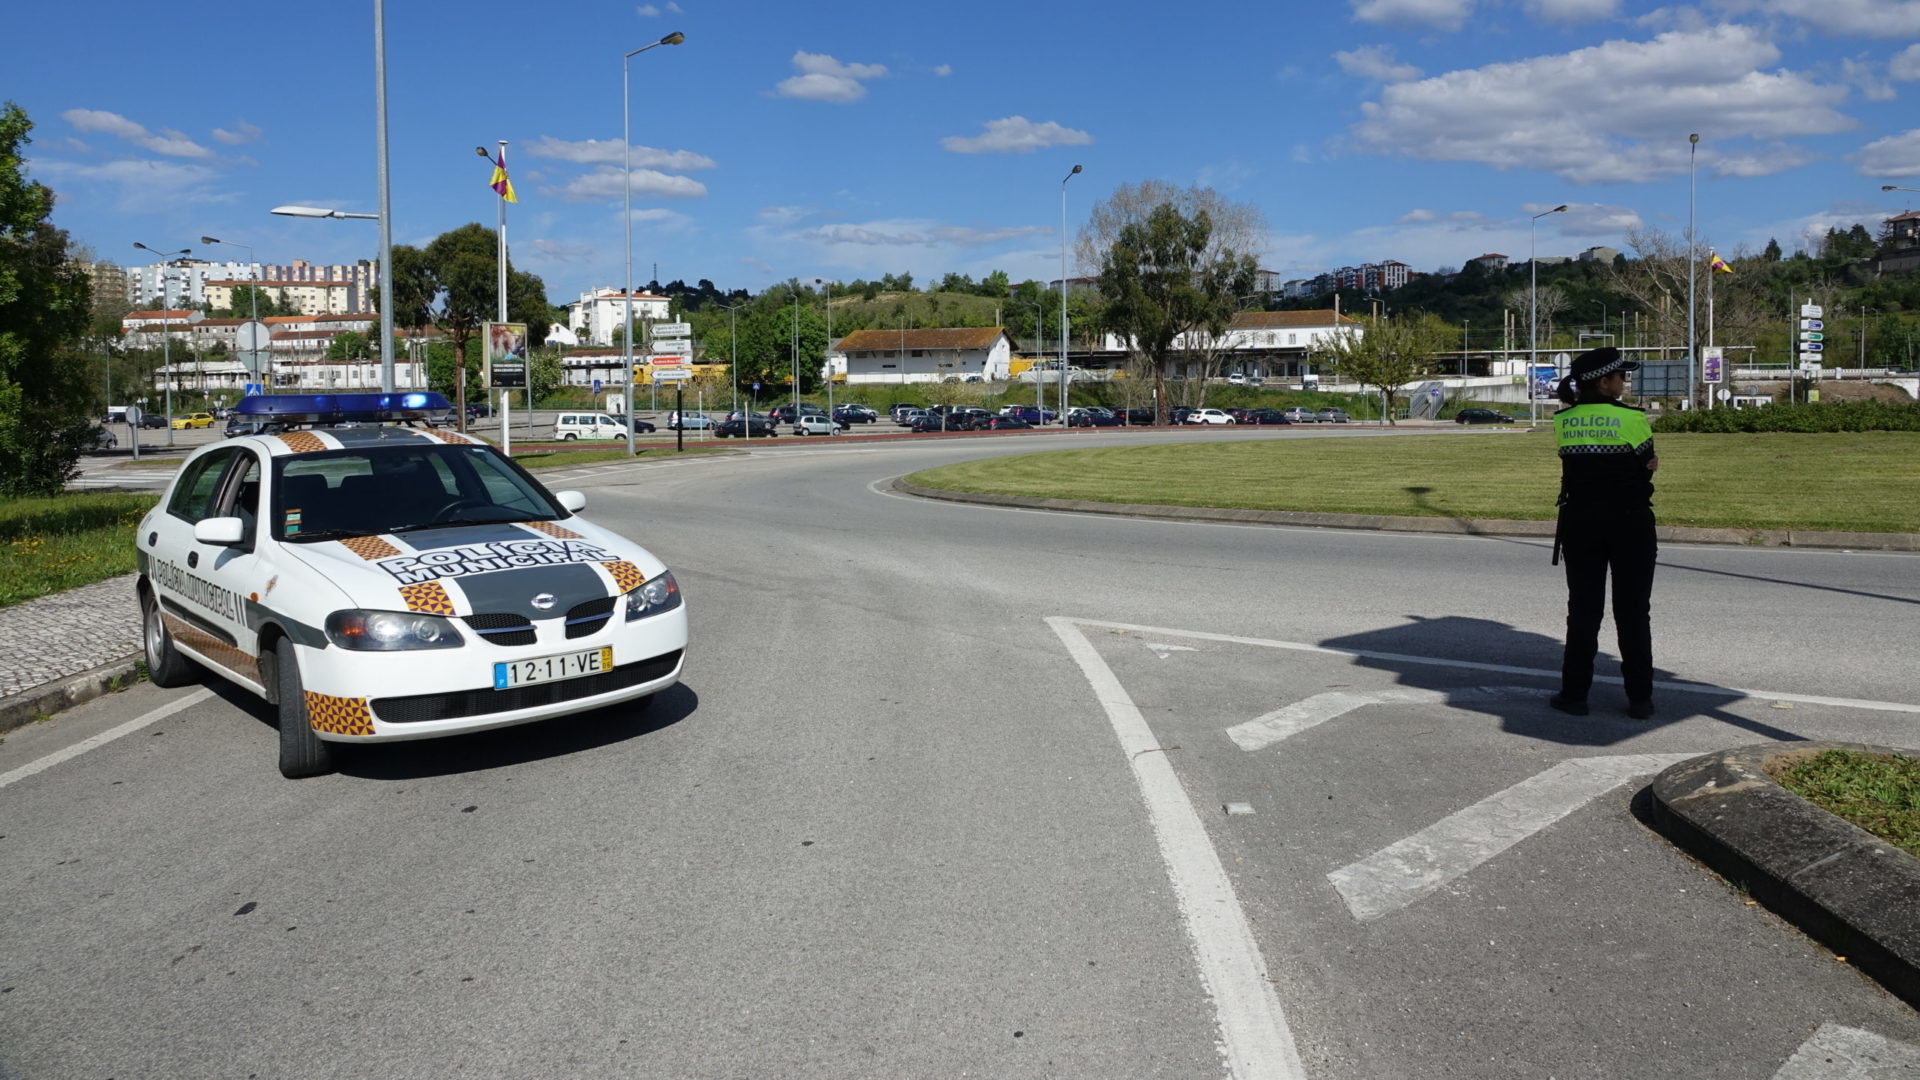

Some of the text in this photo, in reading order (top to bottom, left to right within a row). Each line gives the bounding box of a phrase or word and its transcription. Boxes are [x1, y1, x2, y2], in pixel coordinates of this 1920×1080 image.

[1562, 415, 1621, 428] POLÍCIA
[1563, 429, 1620, 439] MUNICIPAL
[377, 541, 607, 575] POLÍCIA
[393, 551, 620, 585] MUNICIPAL
[157, 559, 235, 621] POLÍCIA MUNICIPAL
